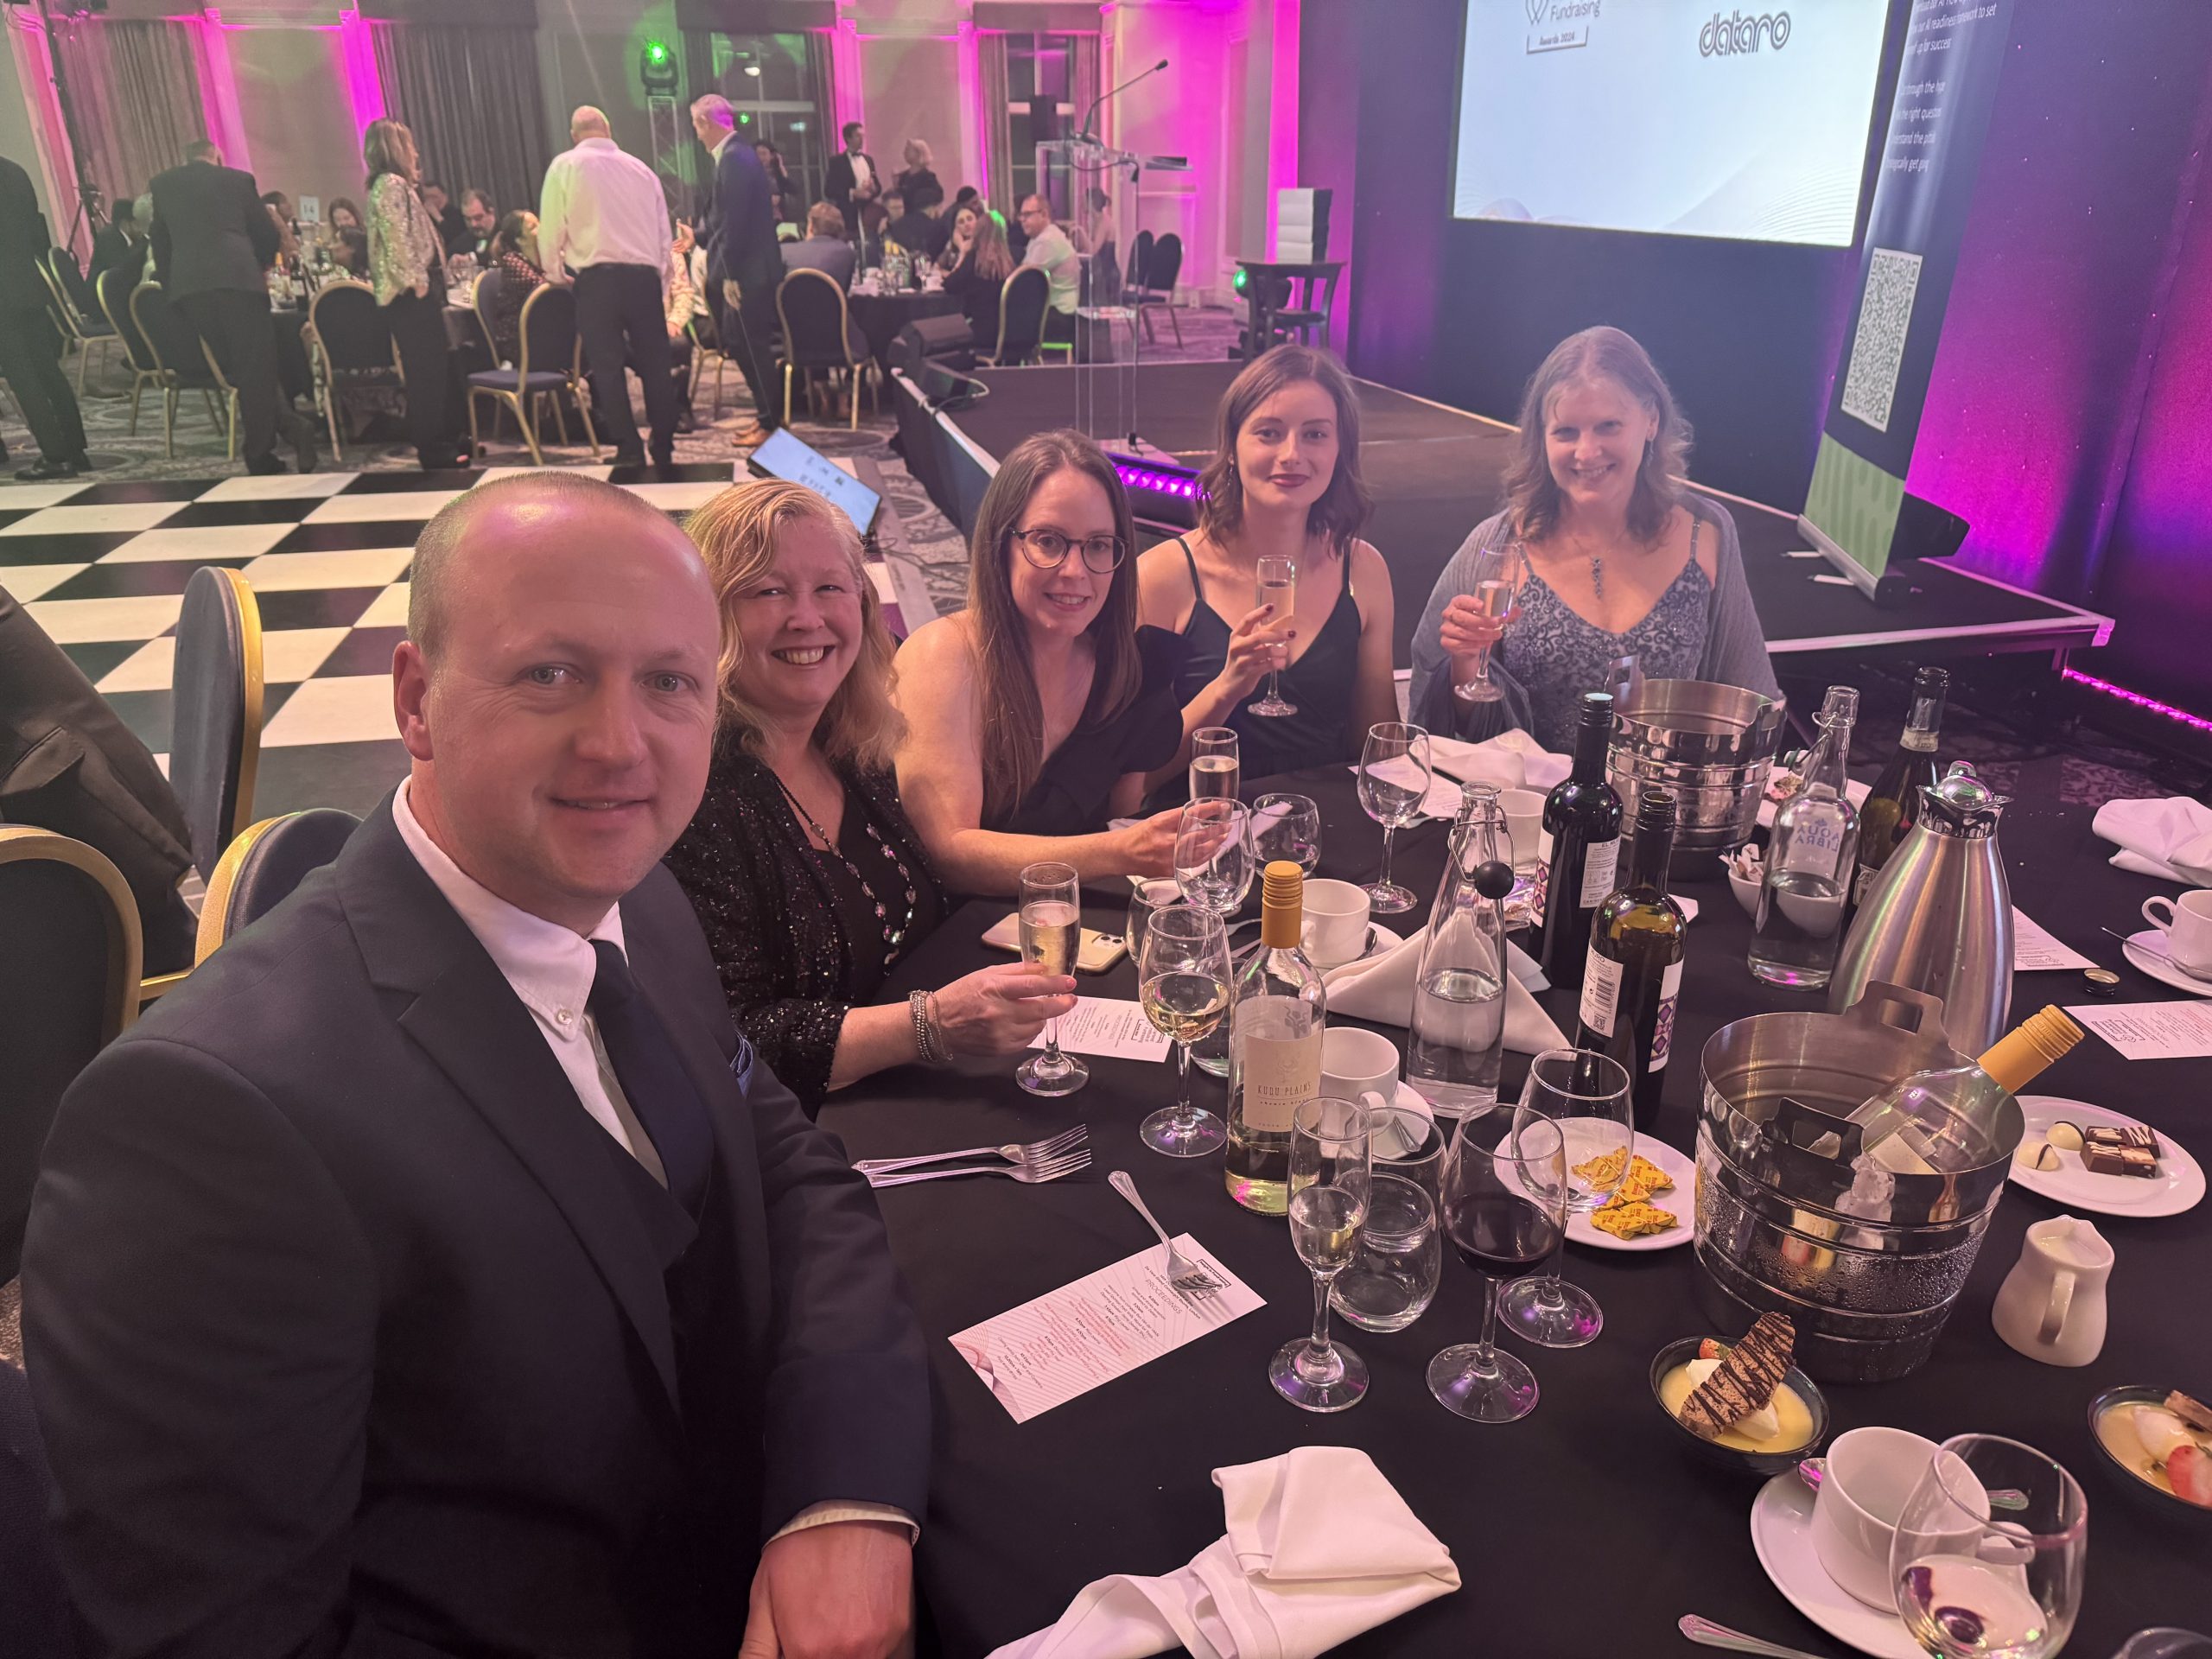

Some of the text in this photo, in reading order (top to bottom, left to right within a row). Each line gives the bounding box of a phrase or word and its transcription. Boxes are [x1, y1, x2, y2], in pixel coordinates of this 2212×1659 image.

[1550, 0, 1601, 22] Fundraising
[1985, 3, 1997, 17] set
[1700, 10, 1791, 57] dataro
[1923, 79, 1936, 94] the
[1258, 1081, 1312, 1096] KUDU PLAINS
[1144, 1279, 1183, 1314] PROCEEDINGS
